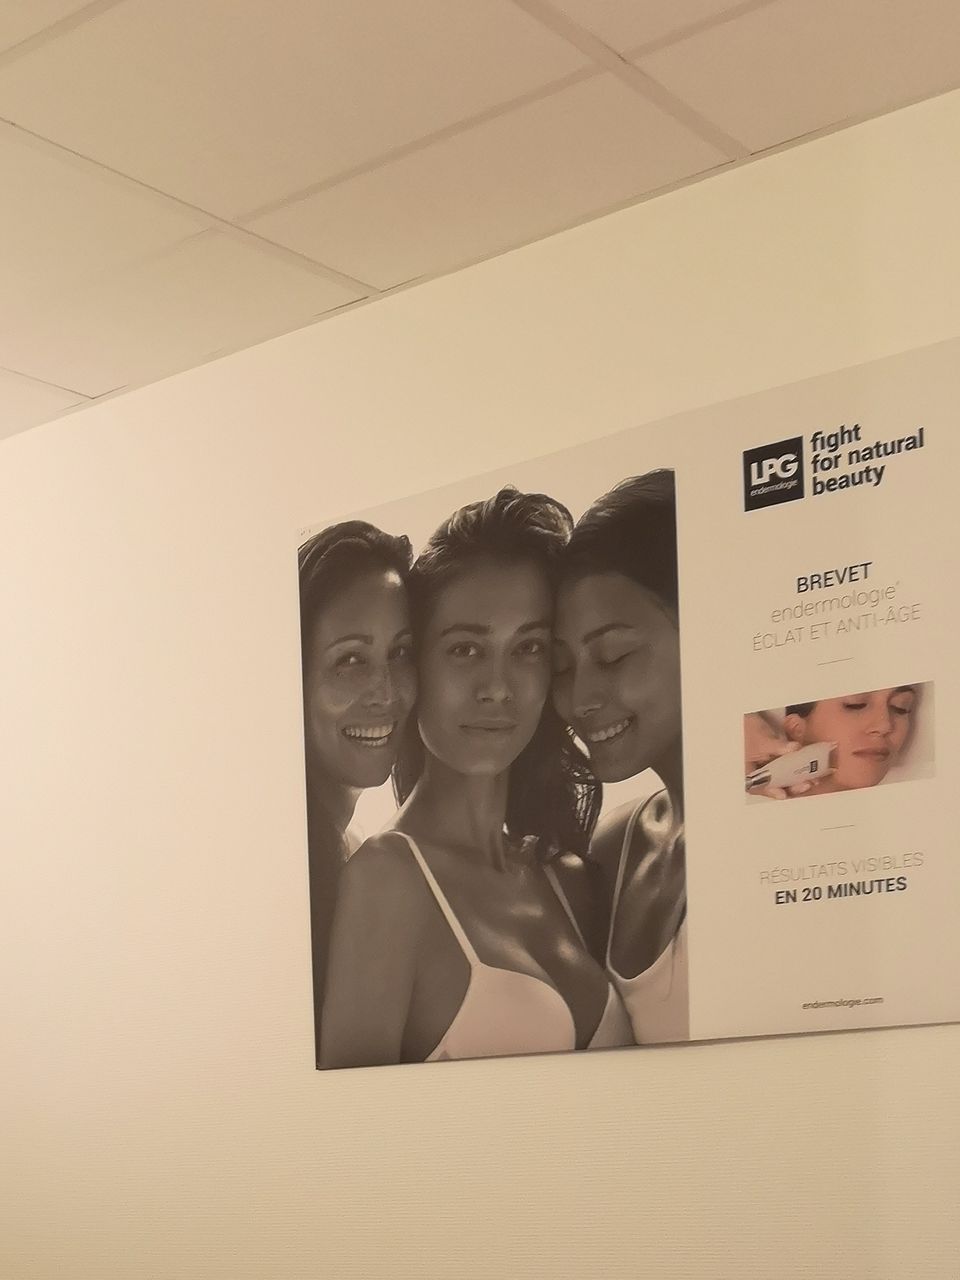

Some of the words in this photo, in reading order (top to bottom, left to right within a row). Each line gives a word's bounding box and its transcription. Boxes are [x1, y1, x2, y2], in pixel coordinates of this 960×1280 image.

[810, 423, 862, 453] fight
[811, 454, 843, 475] for
[848, 427, 925, 466] natural
[751, 453, 799, 487] LPG
[812, 464, 886, 497] beauty
[796, 562, 873, 593] BREVET
[752, 626, 805, 652] ÉCLAT
[810, 620, 832, 641] ET
[836, 602, 922, 635] ANTI-ÂGE
[760, 859, 848, 886] RÉSULTATS
[852, 851, 924, 875] VISIBLES
[775, 889, 798, 906] EN
[802, 885, 823, 902] 20
[827, 876, 908, 900] MINUTES
[801, 995, 885, 1012] endermologie.com
